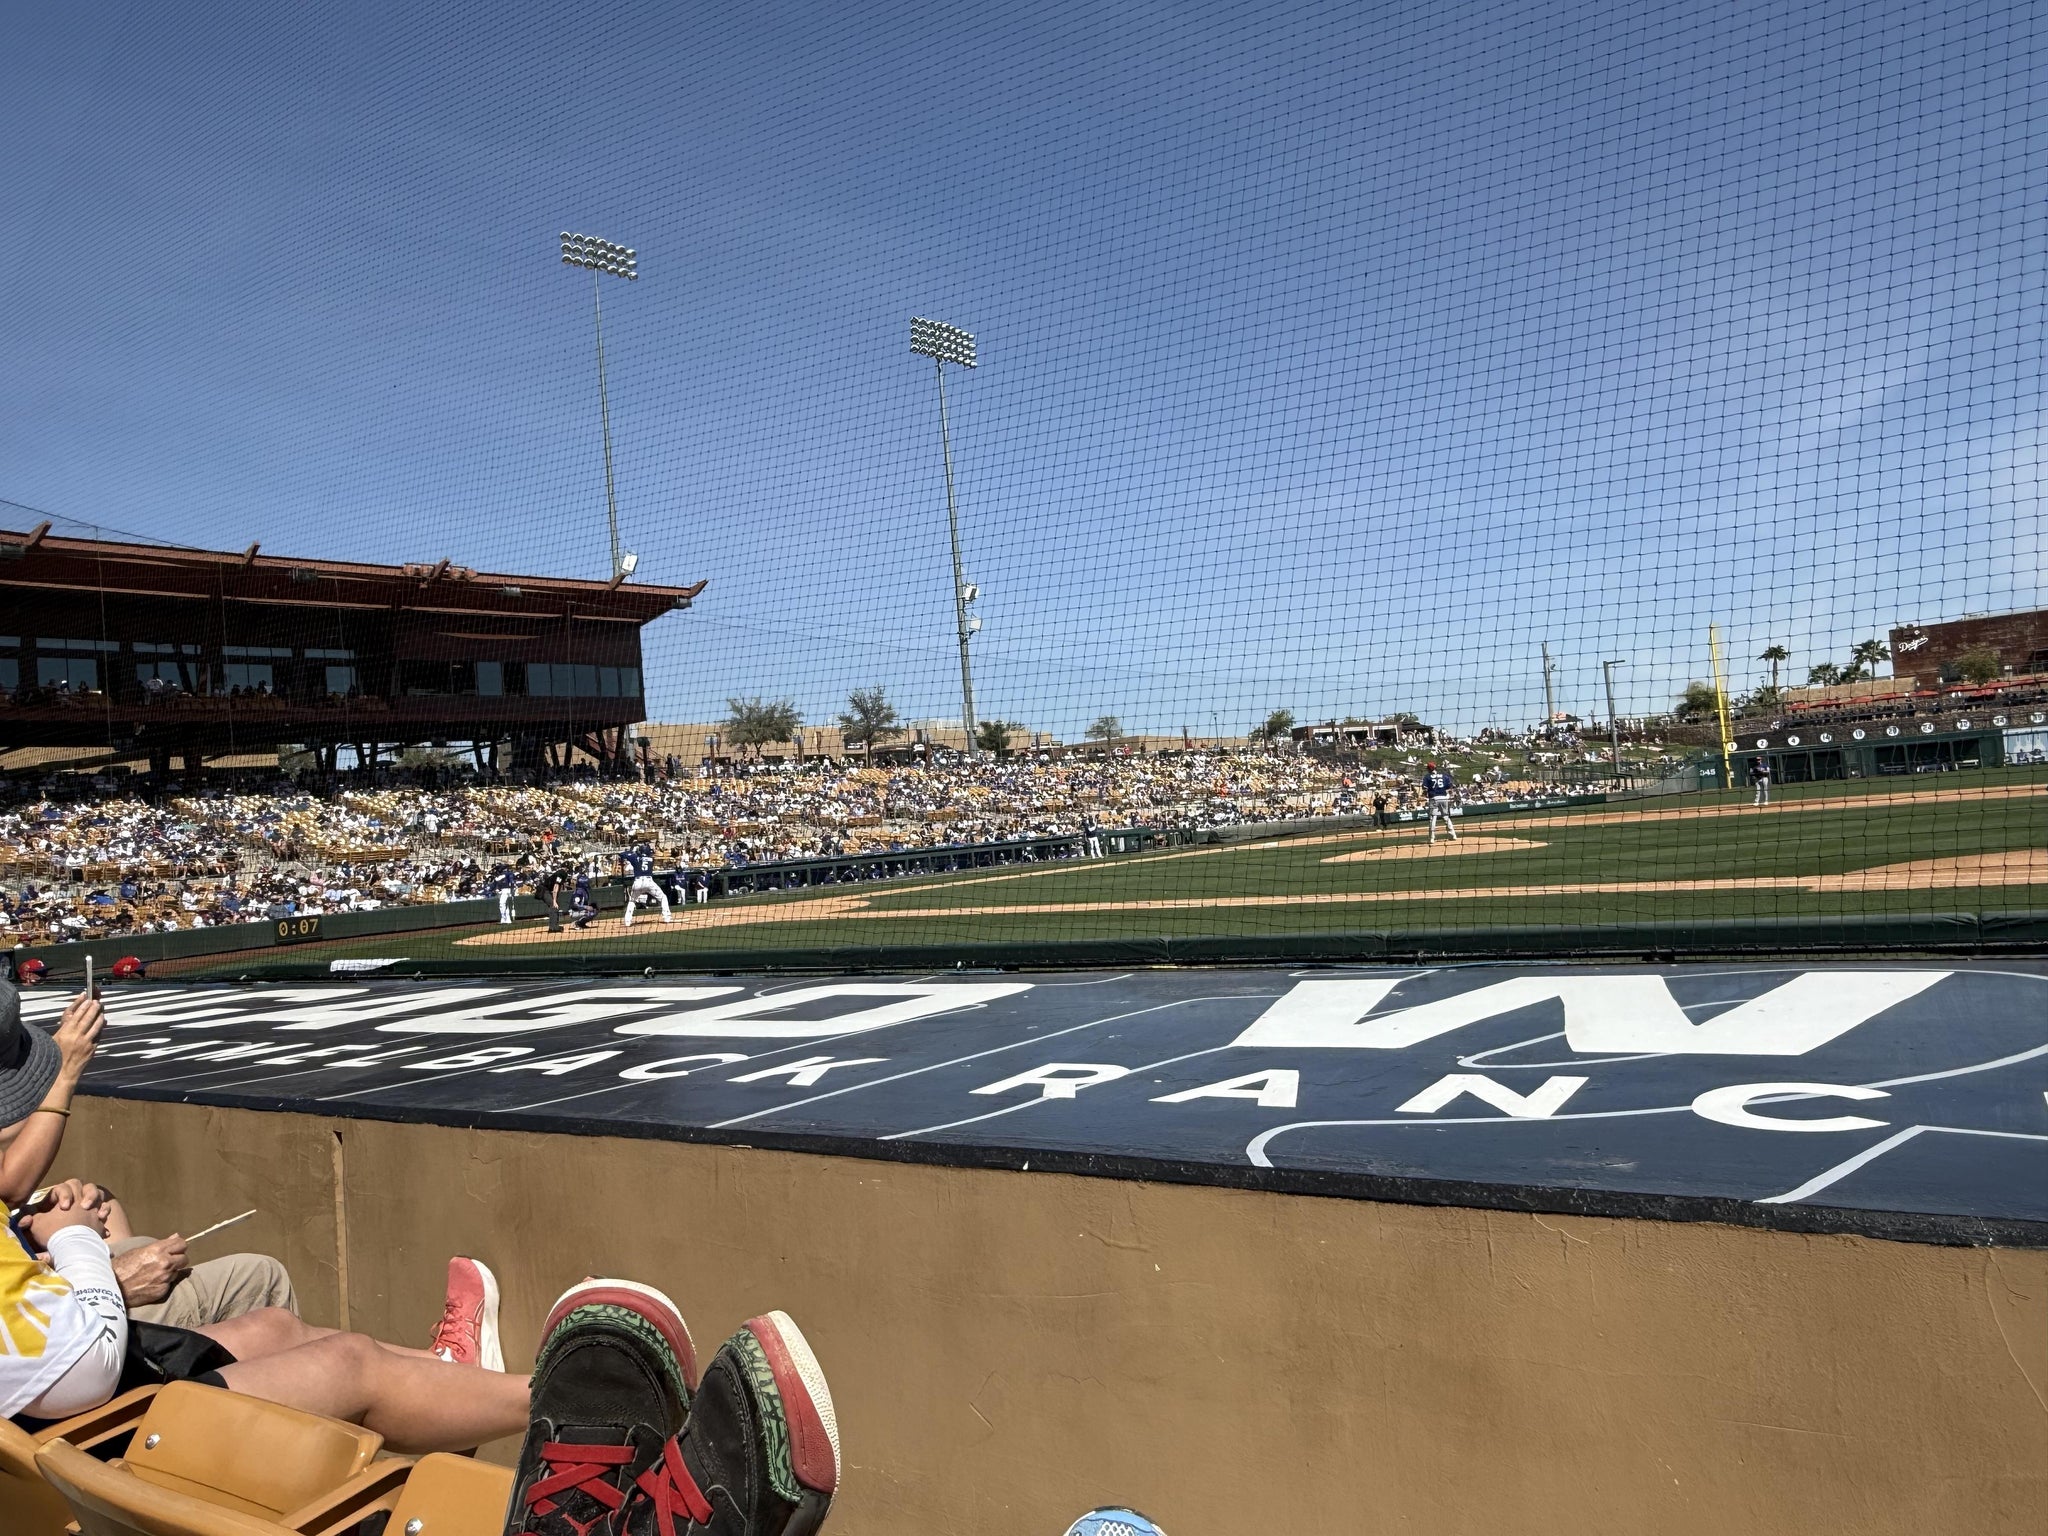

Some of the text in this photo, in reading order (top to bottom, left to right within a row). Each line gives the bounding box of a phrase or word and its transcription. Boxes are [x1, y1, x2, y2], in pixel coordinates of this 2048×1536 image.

[1899, 635, 1929, 653] Dodgers
[641, 861, 649, 871] 5
[278, 918, 319, 937] 0:07
[970, 1062, 2048, 1133] RANC
